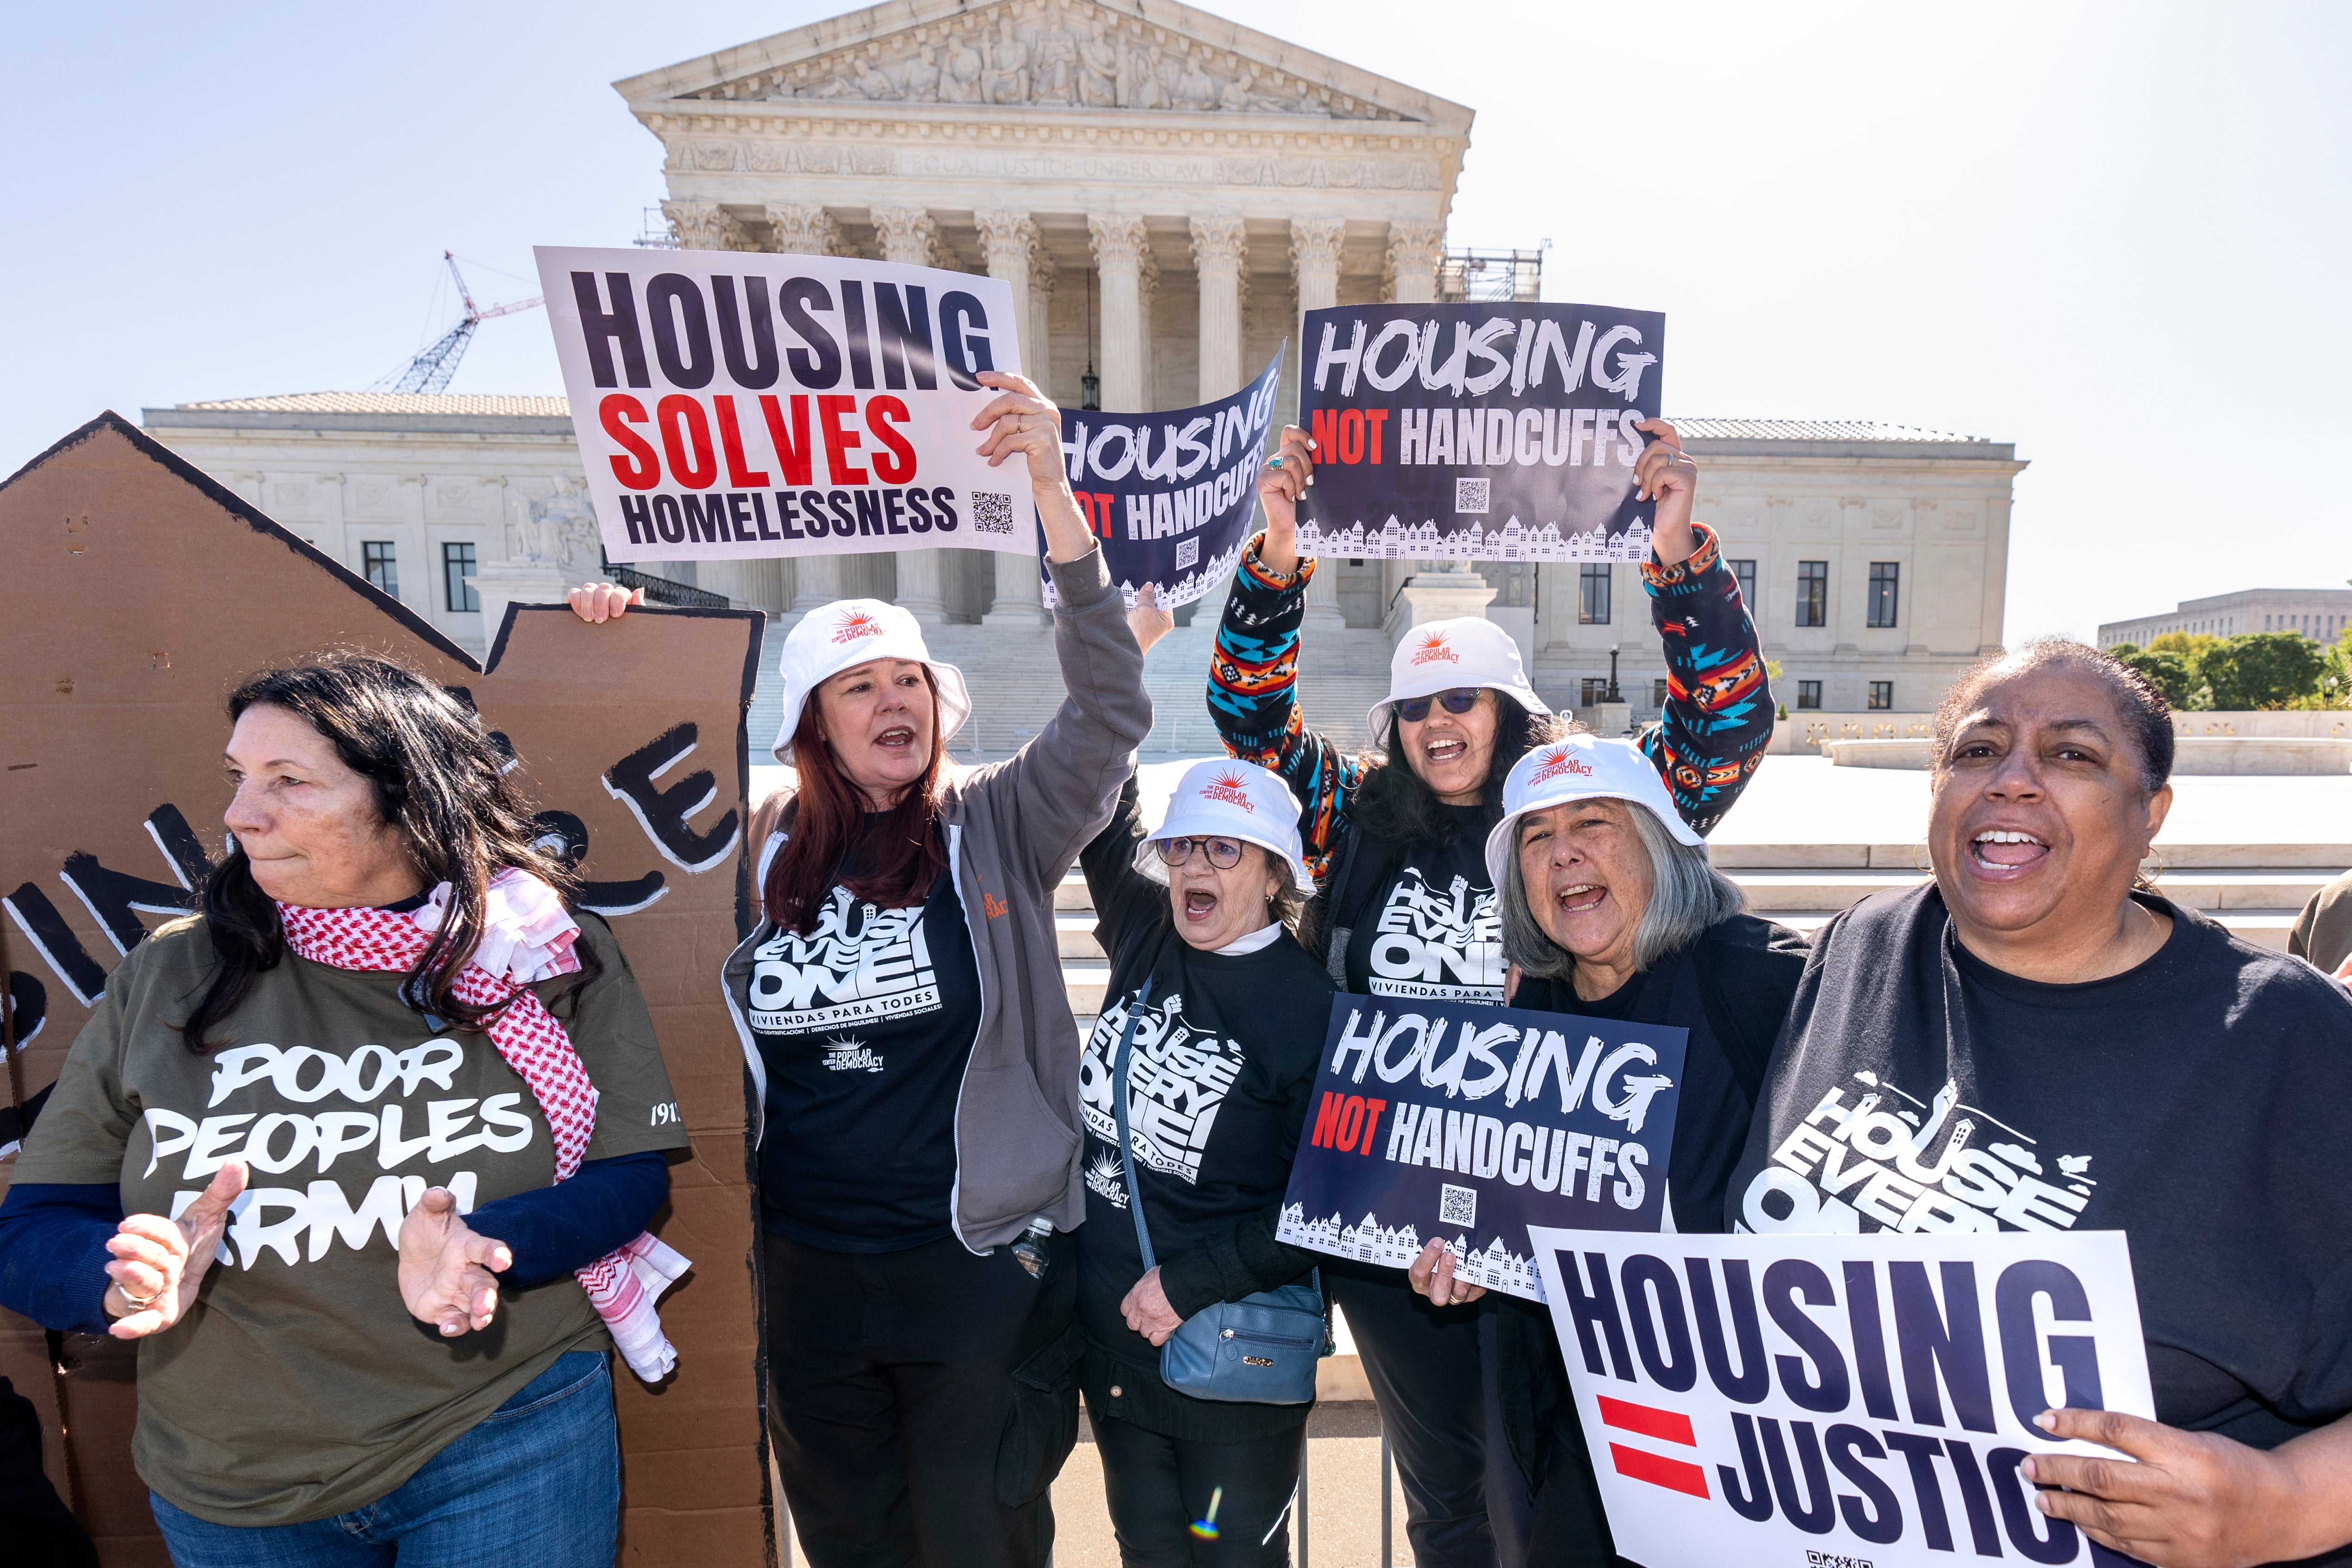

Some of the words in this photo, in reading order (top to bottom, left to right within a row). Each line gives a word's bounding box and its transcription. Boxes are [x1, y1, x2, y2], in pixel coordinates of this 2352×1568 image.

[912, 155, 986, 174] EQUAL
[990, 156, 1073, 177] JUSTICE
[1084, 159, 1154, 179] UNDER
[1162, 163, 1204, 180] LAW
[571, 271, 998, 392] HOUSING
[1314, 317, 1657, 401] HOUSING
[599, 394, 917, 490] SOLVES
[1311, 408, 1388, 465] NOT
[1400, 407, 1645, 467] HANDCUFFS
[619, 487, 958, 545] HOMELESSNESS
[1073, 490, 1114, 539] OT
[845, 623, 881, 634] POPULAR
[1420, 653, 1459, 664] DEMOCRACY
[1421, 647, 1450, 659] POPULAR
[1542, 759, 1579, 774] POPULAR
[1542, 766, 1592, 781] DEMOCRACY
[1214, 786, 1247, 800] POPULAR
[1528, 775, 1541, 786] CENTER
[1212, 791, 1255, 812] DEMOCRACY
[1372, 981, 1446, 997] VIVIENDAS
[751, 1012, 825, 1025] VIVIENDAS
[832, 1003, 875, 1018] PARA
[881, 991, 933, 1010] TODES
[811, 1022, 839, 1033] DERECHOS
[848, 1017, 879, 1028] INQUILINES!
[885, 1010, 913, 1021] VIVIENDAS
[914, 1003, 943, 1016] SOCIALES!
[836, 1056, 884, 1071] DEMOCRACY
[837, 1048, 872, 1062] POPULAR
[209, 1038, 463, 1108] POOR
[1331, 1009, 1674, 1134] HOUSING
[144, 1092, 533, 1180] PEOPLES
[1095, 1131, 1117, 1146] DERECHOS
[1147, 1164, 1173, 1174] VIVIENDAS
[1173, 1170, 1196, 1186] SOCIALES!
[1150, 1151, 1192, 1175] TODES
[1311, 1092, 1387, 1156] NOT
[1385, 1101, 1649, 1210] HANDCUFFS
[1091, 1180, 1130, 1204] DEMOCRACY
[1094, 1171, 1121, 1192] POPULAR
[1554, 1249, 2105, 1441] HOUSING
[1716, 1412, 2080, 1565] JUSTIC
